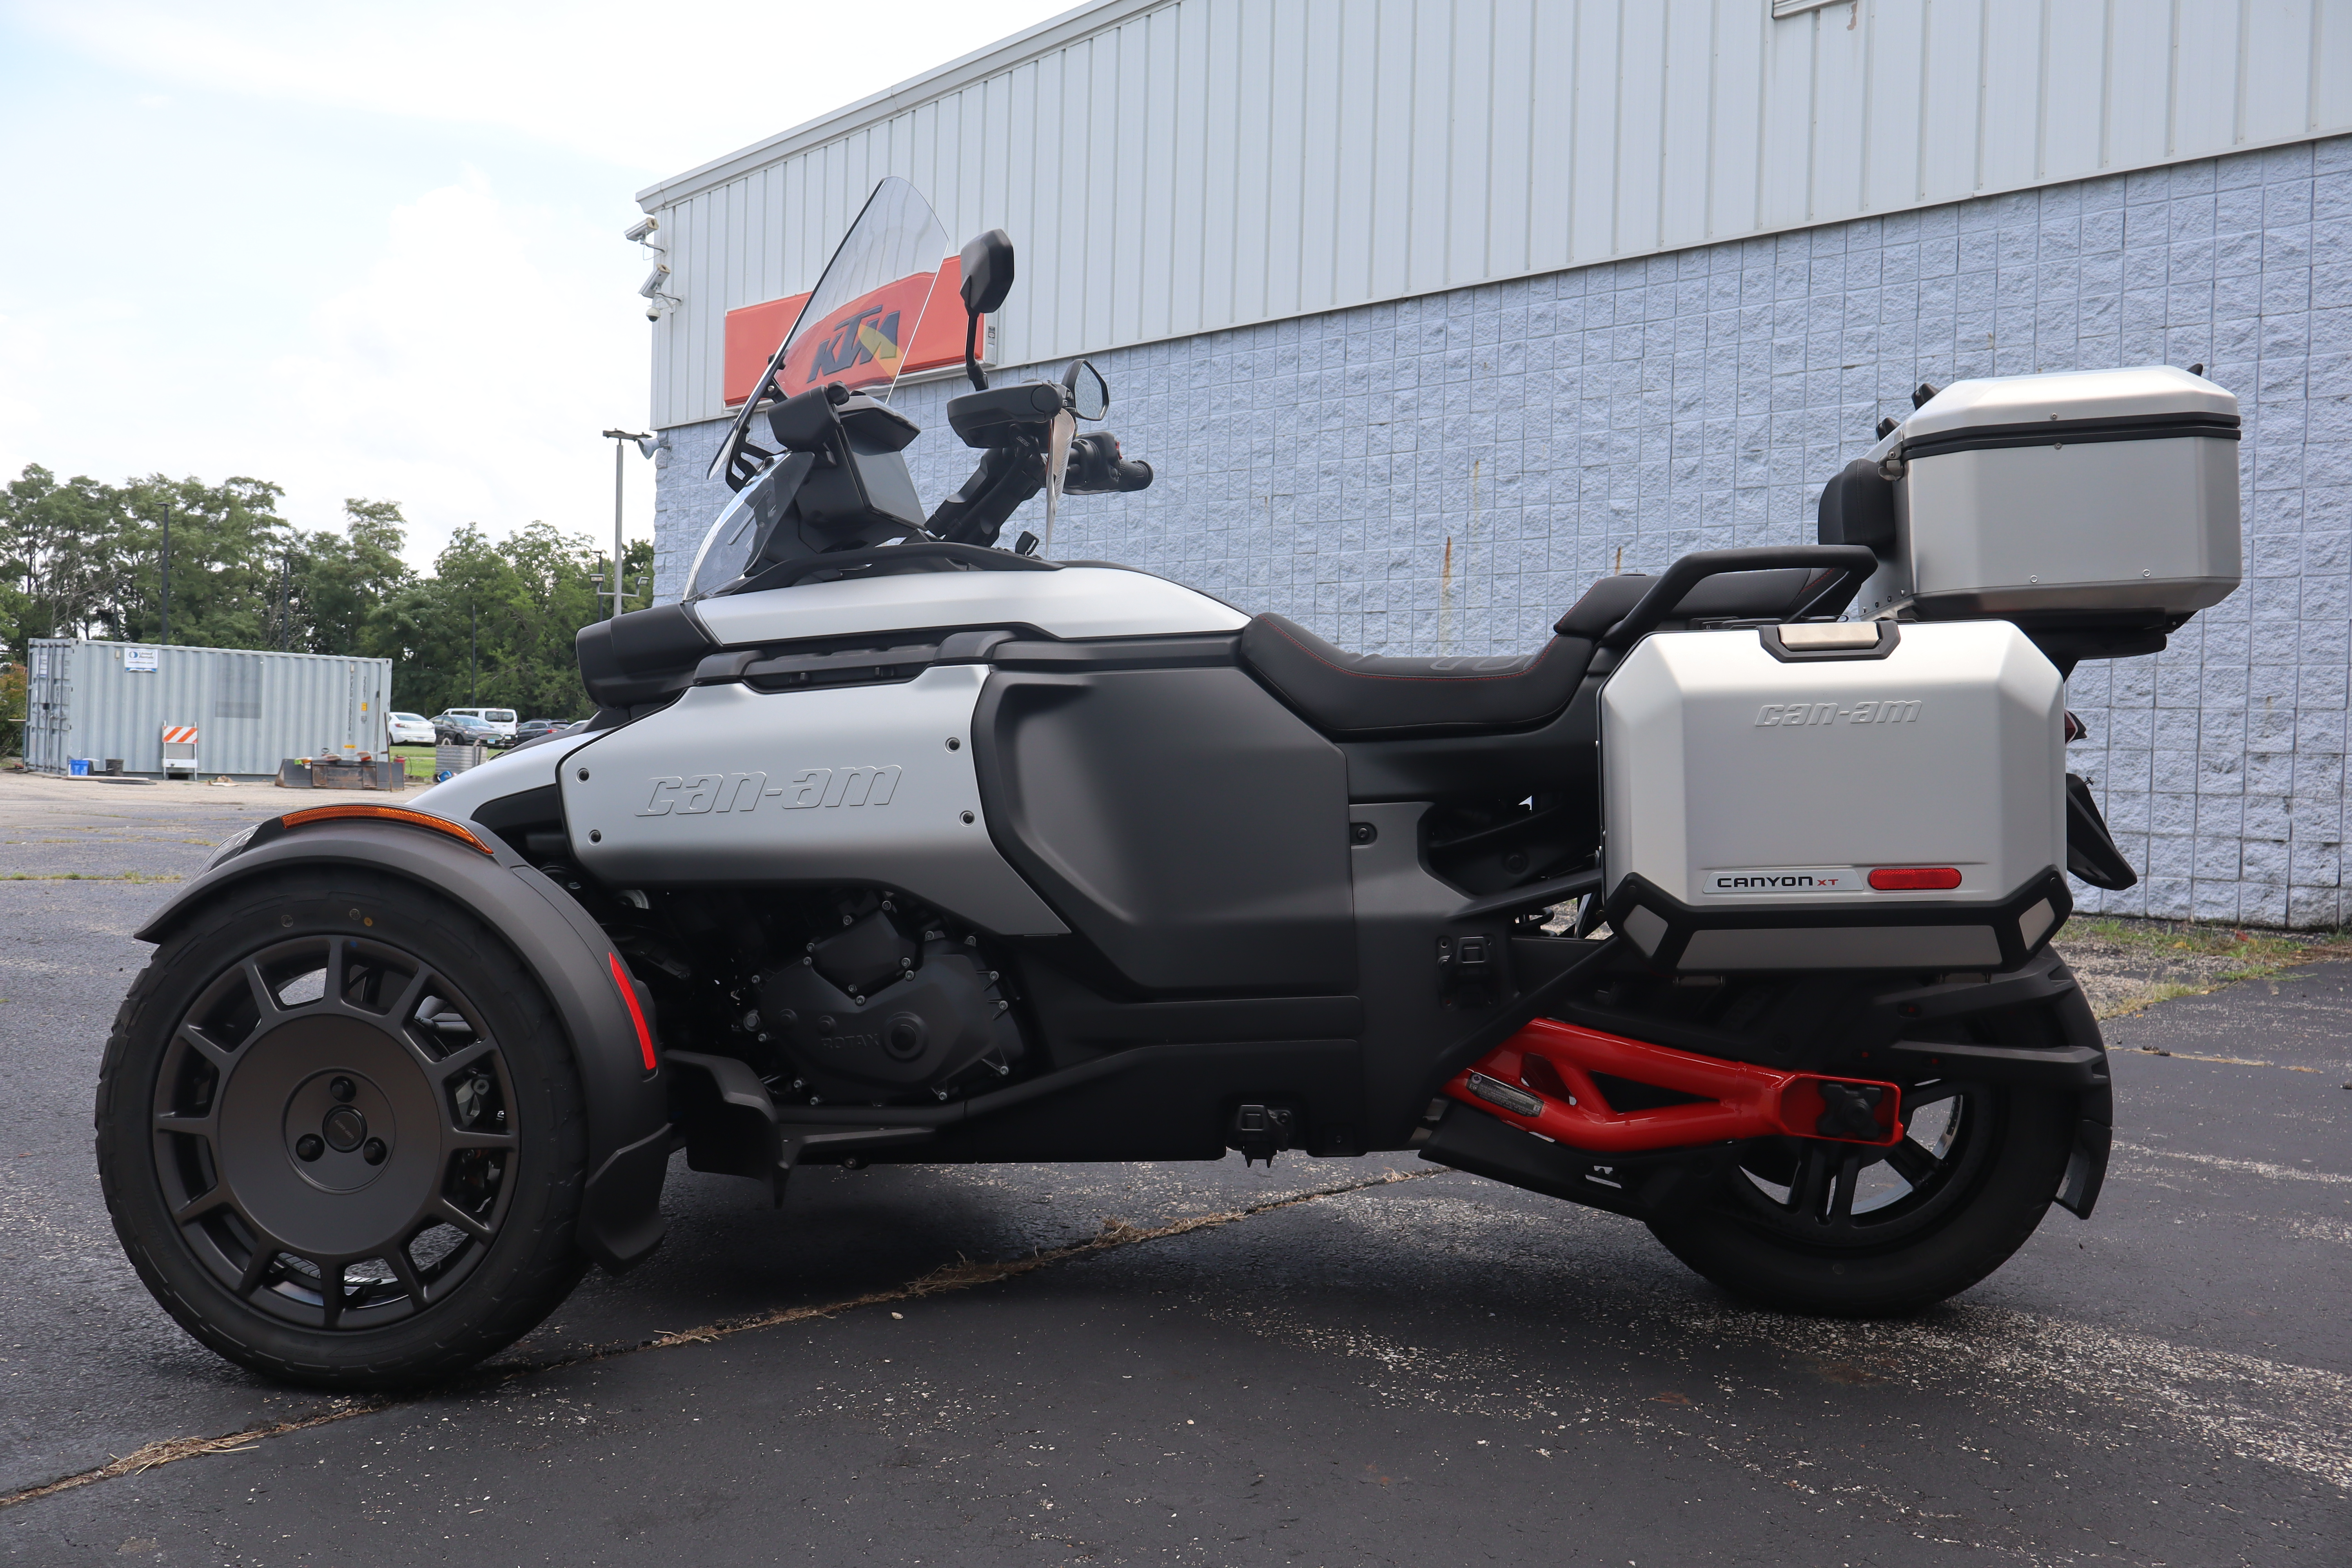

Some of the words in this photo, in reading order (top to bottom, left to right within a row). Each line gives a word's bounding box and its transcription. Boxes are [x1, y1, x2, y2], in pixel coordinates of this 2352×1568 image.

[806, 305, 900, 384] KTM
[1016, 436, 1030, 447] SE6
[1755, 700, 1922, 727] can-am
[634, 764, 902, 817] can-am
[1717, 877, 1813, 888] CANYON
[820, 1033, 880, 1050] ROTAX
